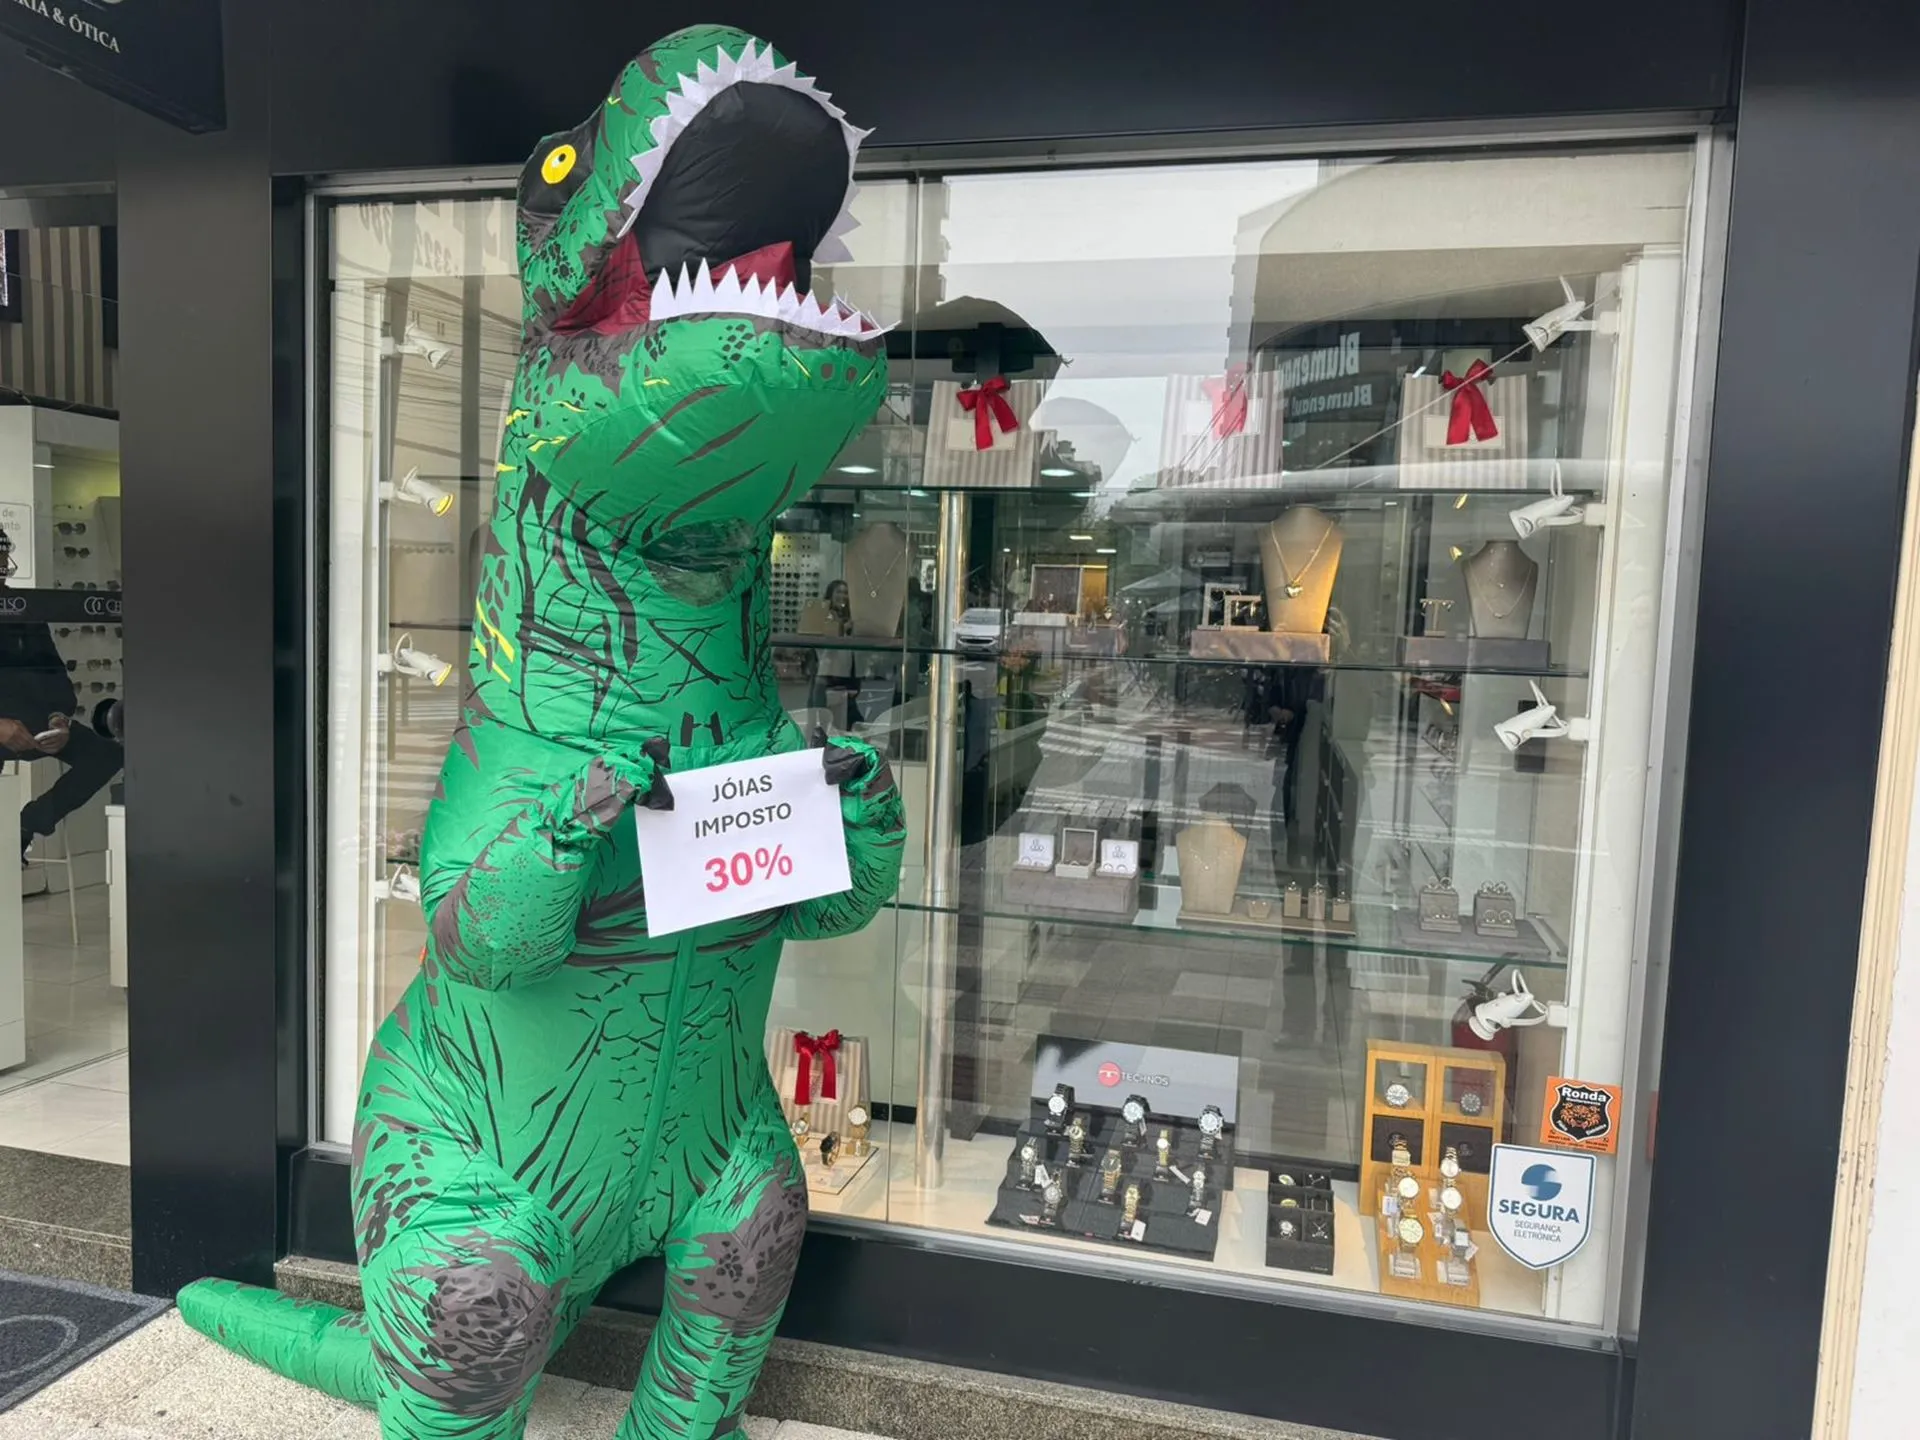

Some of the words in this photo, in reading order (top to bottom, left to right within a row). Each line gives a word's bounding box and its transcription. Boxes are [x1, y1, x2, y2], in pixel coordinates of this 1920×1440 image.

[52, 7, 66, 26] &
[68, 14, 121, 53] ÓTICA
[712, 774, 773, 802] JÓIAS
[694, 802, 792, 838] IMPOSTO
[704, 844, 793, 893] 30%
[1121, 1071, 1169, 1087] TECHNOS
[1561, 1087, 1607, 1102] Ronda
[1498, 1199, 1580, 1224] SEGURA
[1514, 1219, 1562, 1234] SEGURANÇA
